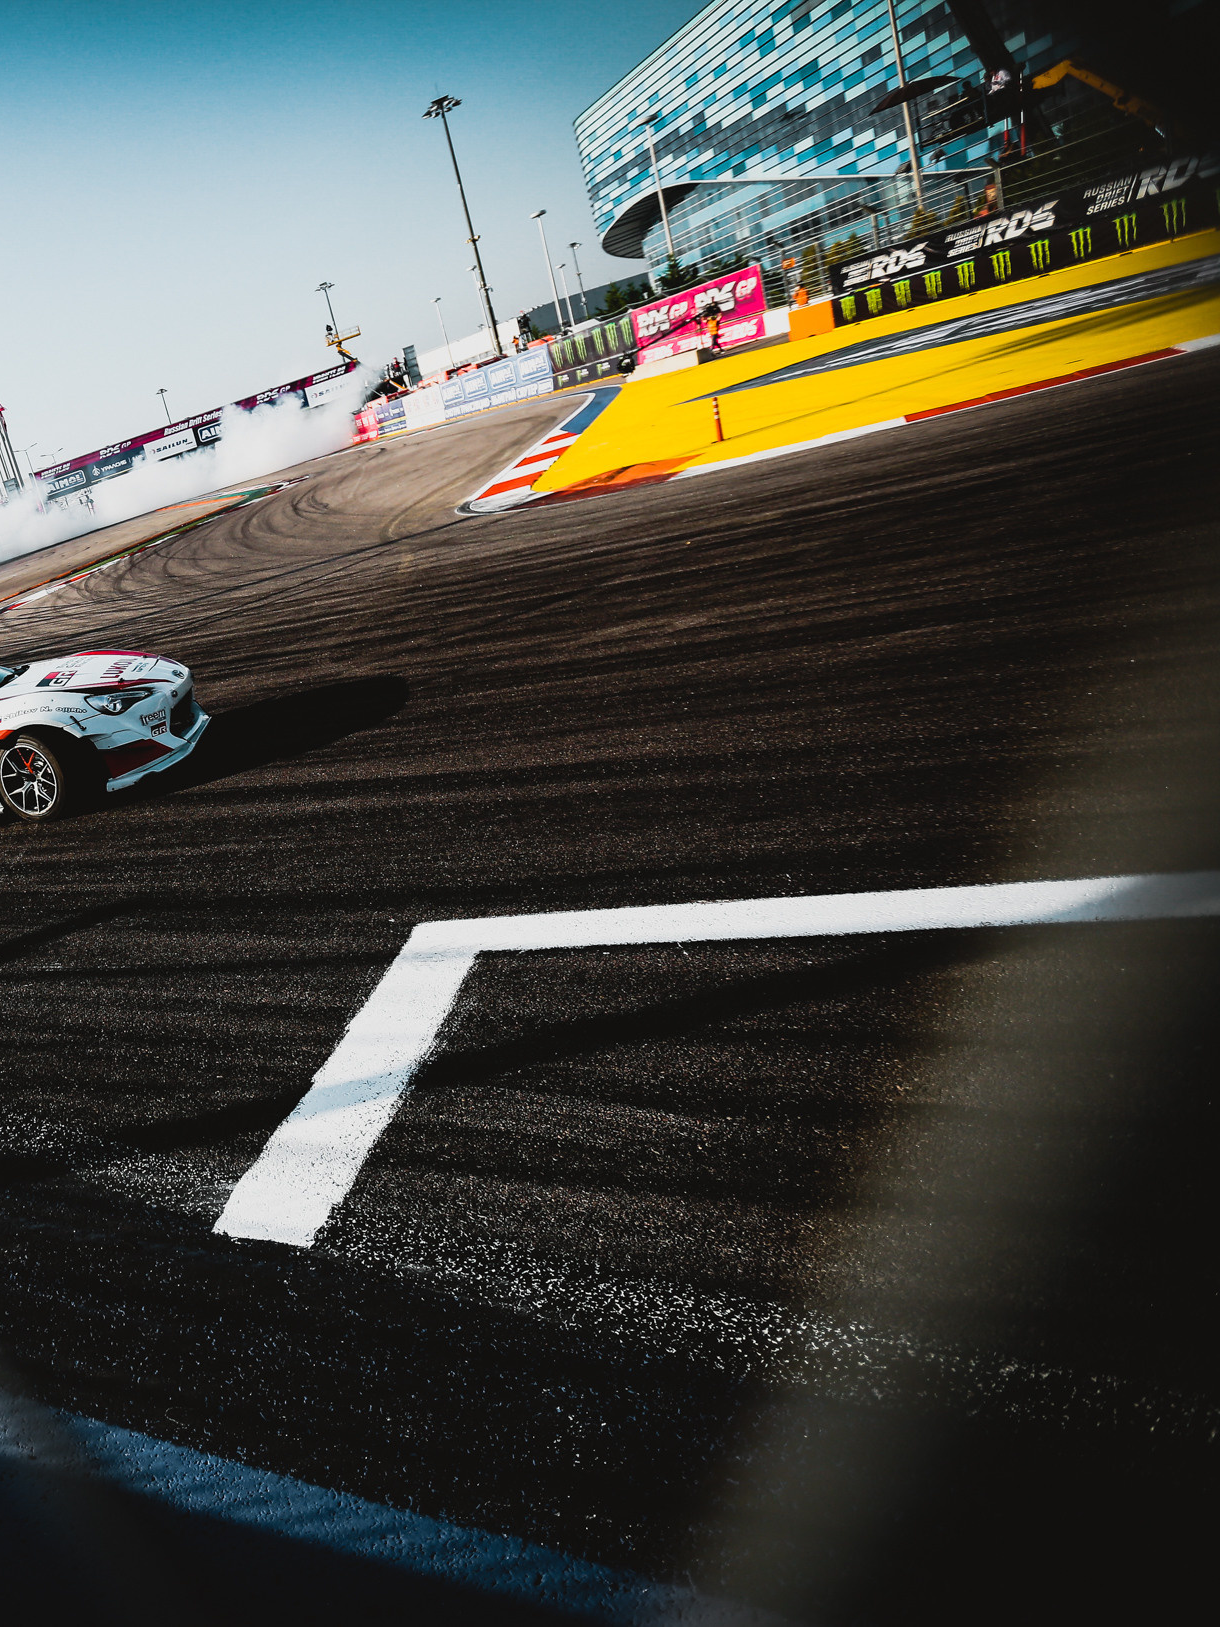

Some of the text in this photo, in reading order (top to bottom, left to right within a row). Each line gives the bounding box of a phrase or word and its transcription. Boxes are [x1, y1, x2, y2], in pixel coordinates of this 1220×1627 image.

[1083, 175, 1132, 199] RUSSIAN
[1095, 185, 1129, 204] DRIFT
[1086, 195, 1125, 215] SERIES
[984, 199, 1059, 247] RDS
[871, 241, 929, 280] RDS
[735, 277, 757, 298] GP
[164, 410, 223, 436] Russian Drift Series
[156, 438, 188, 453] SAILUN
[46, 473, 81, 494] AIMOL
[151, 725, 167, 738] GR
